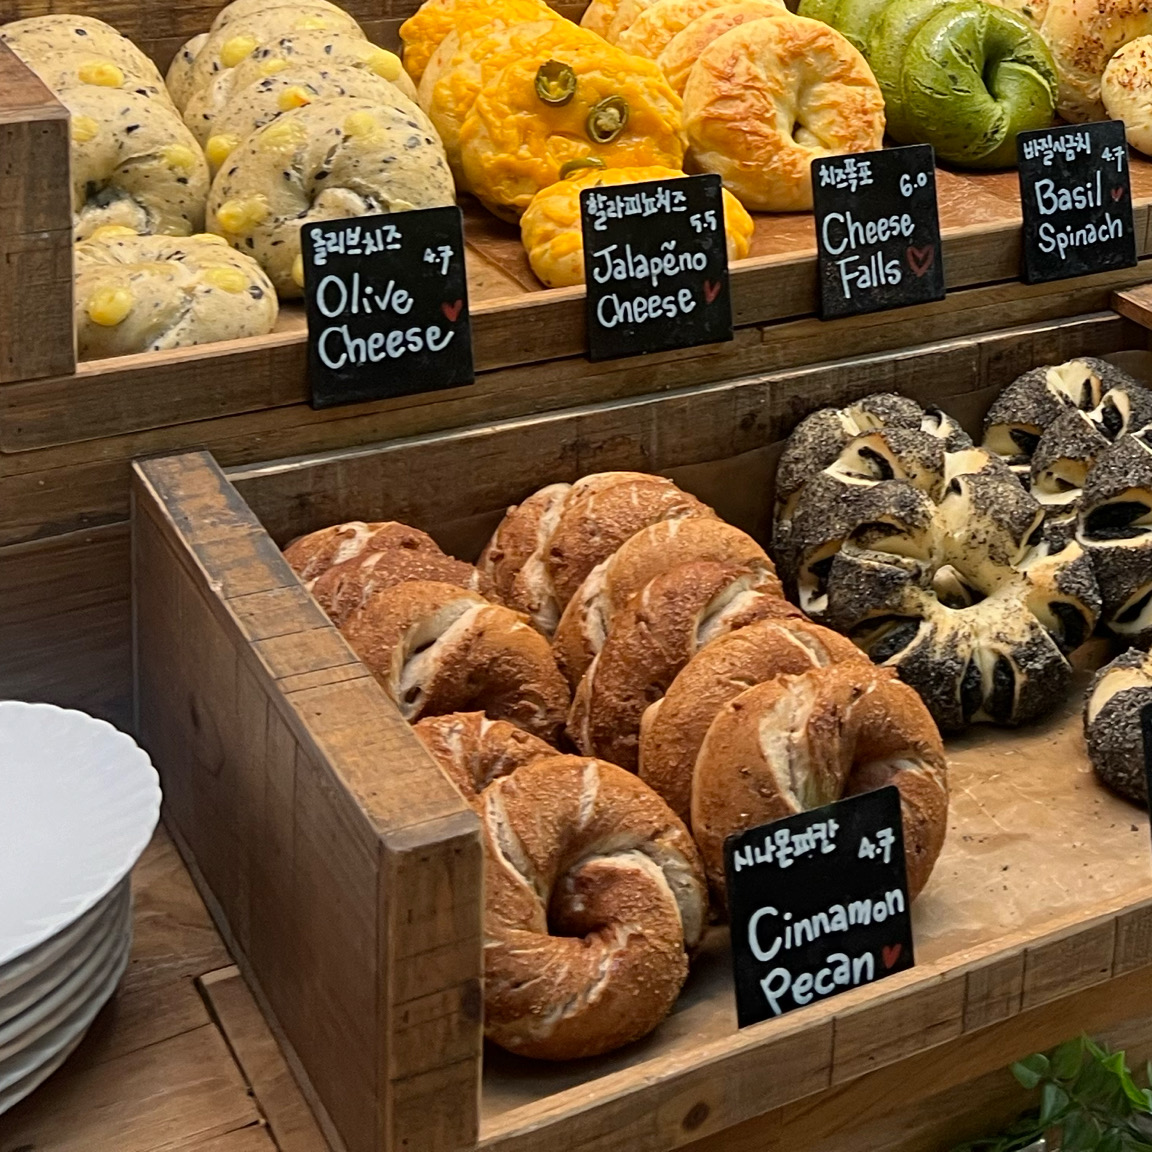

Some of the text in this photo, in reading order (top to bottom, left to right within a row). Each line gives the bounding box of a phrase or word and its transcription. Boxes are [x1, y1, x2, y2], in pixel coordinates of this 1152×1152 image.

[1023, 132, 1091, 166] 바질시금치
[819, 158, 928, 197] 치즈폭포 6.0
[1034, 170, 1102, 215] Basil
[690, 210, 717, 233] 5.5
[822, 211, 915, 255] Cheese
[1038, 212, 1123, 260] Spinach
[310, 225, 402, 266] 올리브치즈
[316, 272, 414, 318] Olive
[836, 250, 902, 299] Falls
[597, 288, 697, 328] Cheese
[318, 325, 455, 369] Cheese
[857, 827, 896, 864] 4.7
[748, 888, 905, 962] Cinnamon
[760, 951, 875, 1016] Pecan
